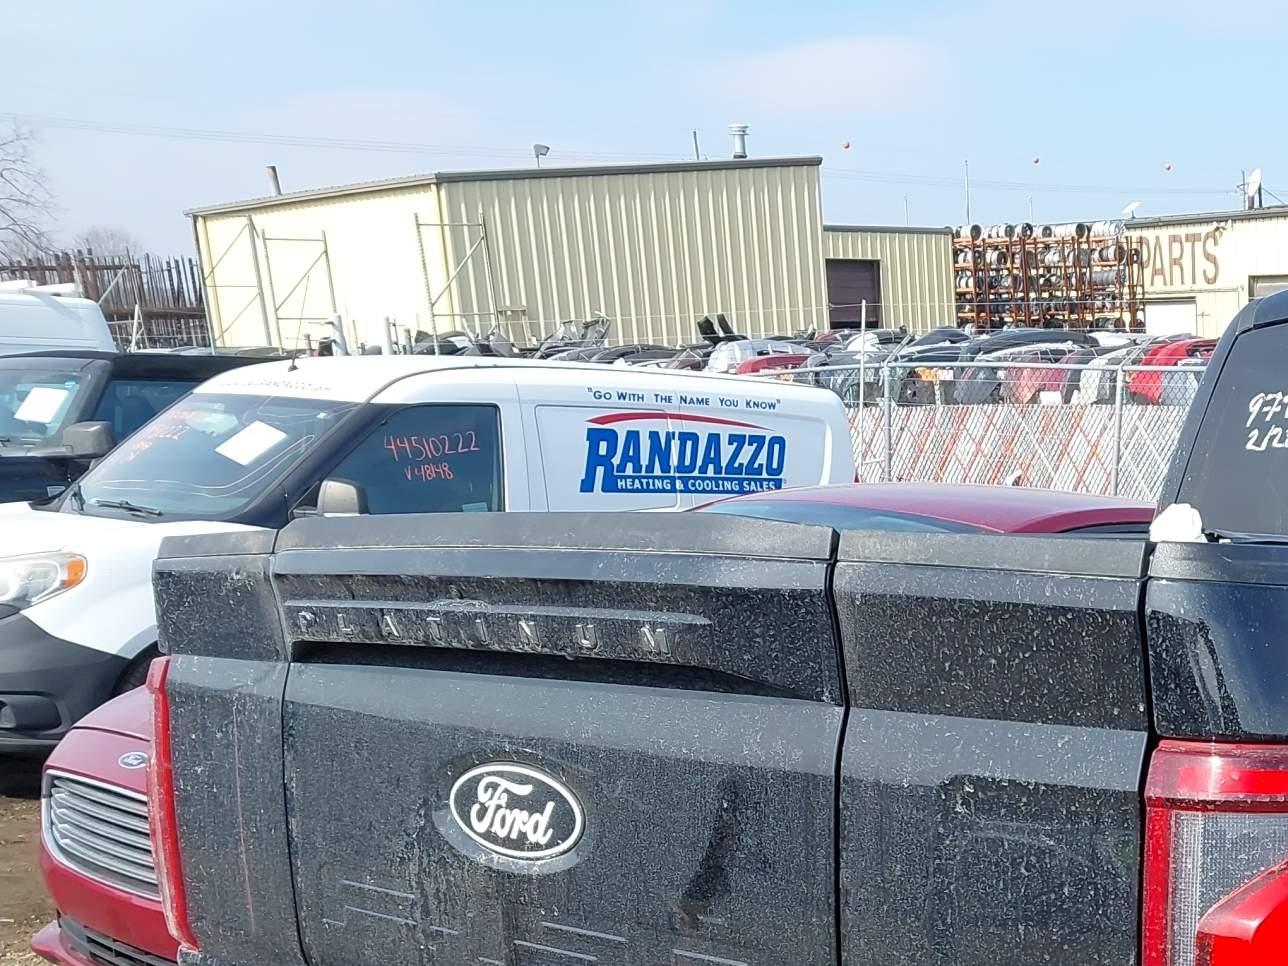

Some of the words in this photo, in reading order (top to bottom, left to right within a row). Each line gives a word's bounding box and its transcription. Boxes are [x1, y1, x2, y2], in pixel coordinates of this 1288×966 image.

[1136, 230, 1220, 286] PARTS
[384, 431, 481, 462] 44510222
[617, 478, 671, 490] HEATING
[676, 480, 685, 490] &
[688, 480, 740, 491] COOLING
[743, 480, 776, 492] SALES
[298, 610, 672, 657] PLATINUM
[470, 775, 556, 845] Ford
